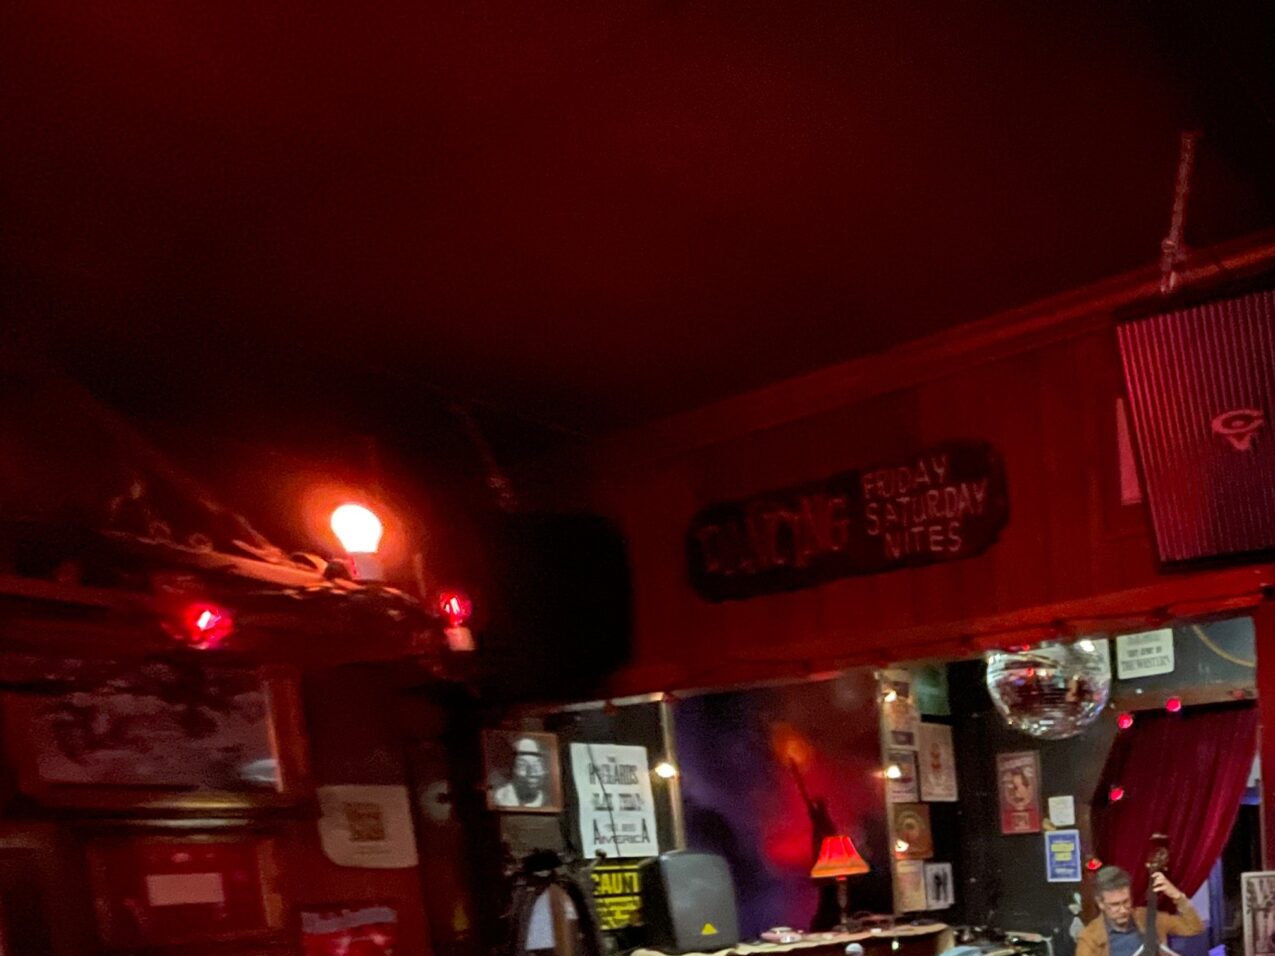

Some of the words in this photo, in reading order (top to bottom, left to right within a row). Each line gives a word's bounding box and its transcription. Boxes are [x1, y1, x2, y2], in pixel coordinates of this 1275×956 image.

[861, 454, 949, 499] FRIDAY
[865, 477, 988, 536] SATURDAY
[884, 520, 963, 559] NITES
